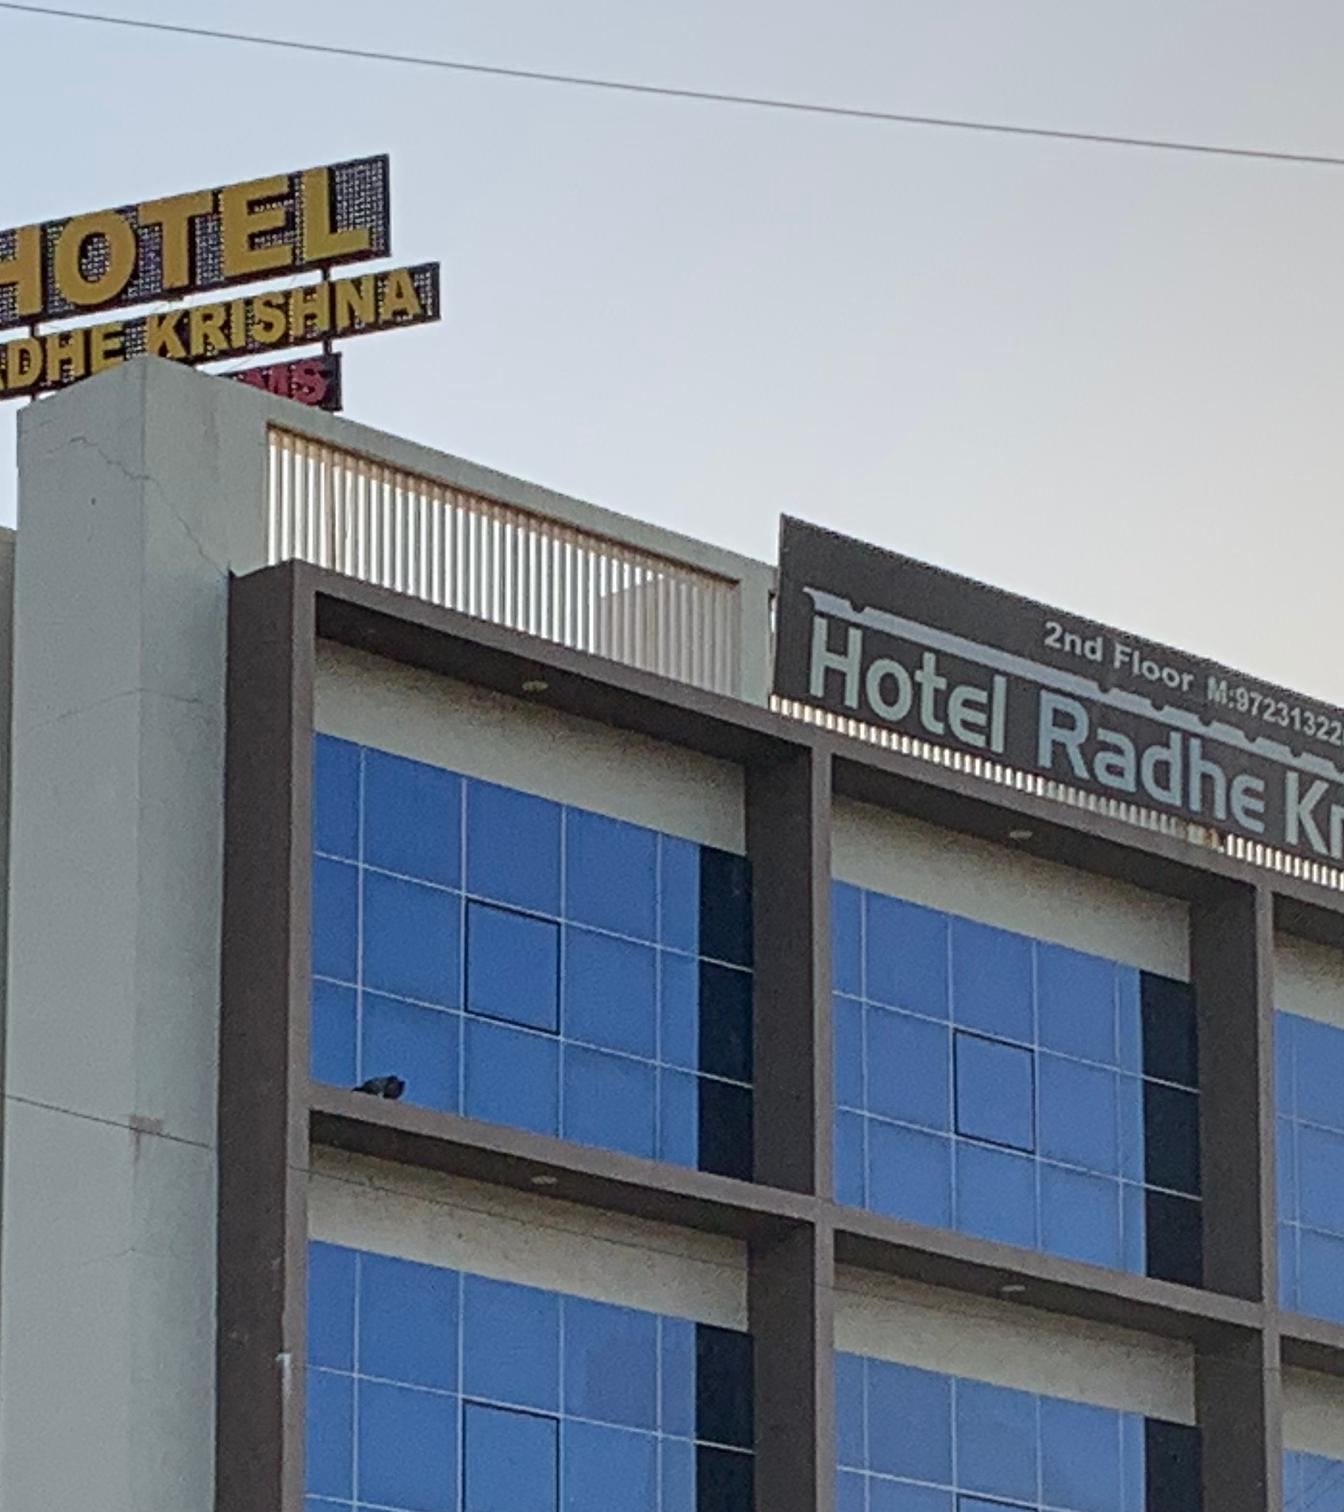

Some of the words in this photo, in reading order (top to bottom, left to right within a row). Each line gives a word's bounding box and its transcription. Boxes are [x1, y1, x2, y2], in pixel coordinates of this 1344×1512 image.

[145, 268, 424, 360] KRISHNA
[1044, 621, 1103, 662] 2nd
[1113, 641, 1195, 692] Floor
[807, 614, 1007, 755] Hotel
[1037, 690, 1266, 836] Radhe
